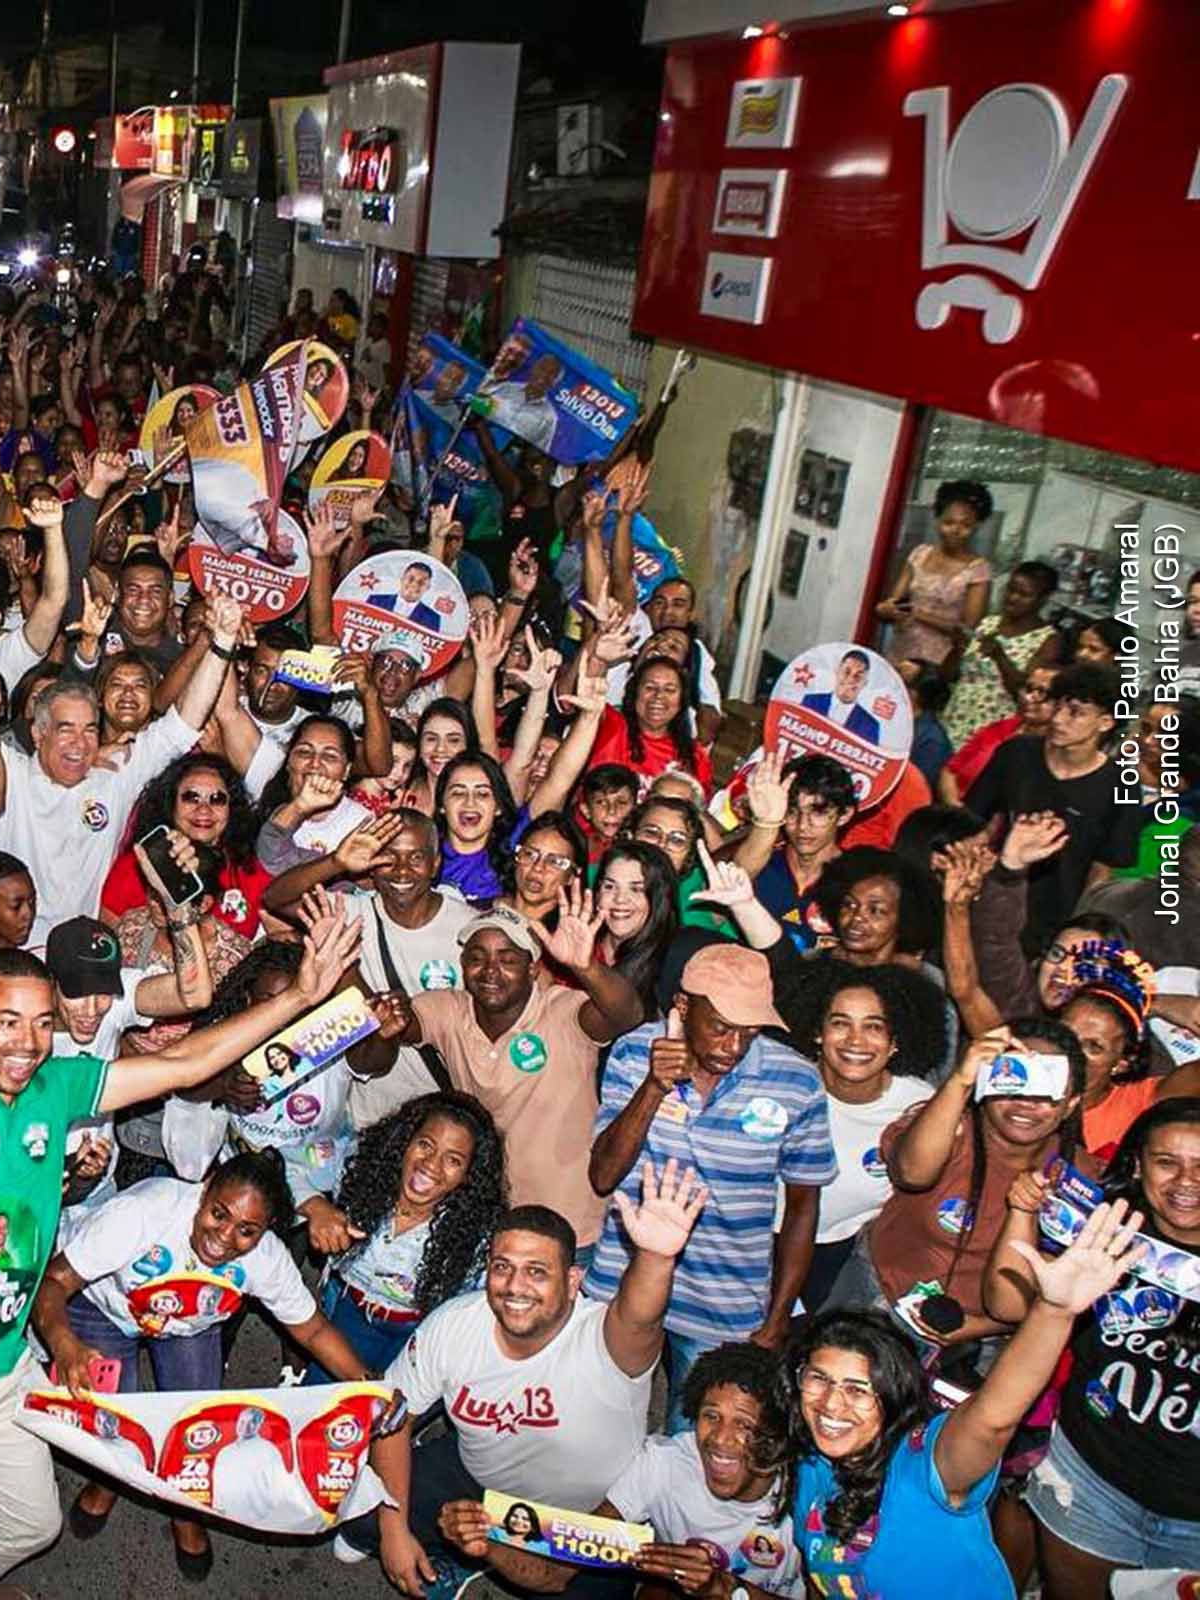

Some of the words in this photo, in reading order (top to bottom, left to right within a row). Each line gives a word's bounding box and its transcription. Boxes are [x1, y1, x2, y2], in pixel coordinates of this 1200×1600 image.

[581, 385, 626, 418] 13013
[201, 555, 246, 575] MAGNO
[204, 572, 286, 611] 13070
[343, 610, 395, 633] MAGNO
[779, 714, 830, 745] MAGNO
[524, 1387, 554, 1418] 13
